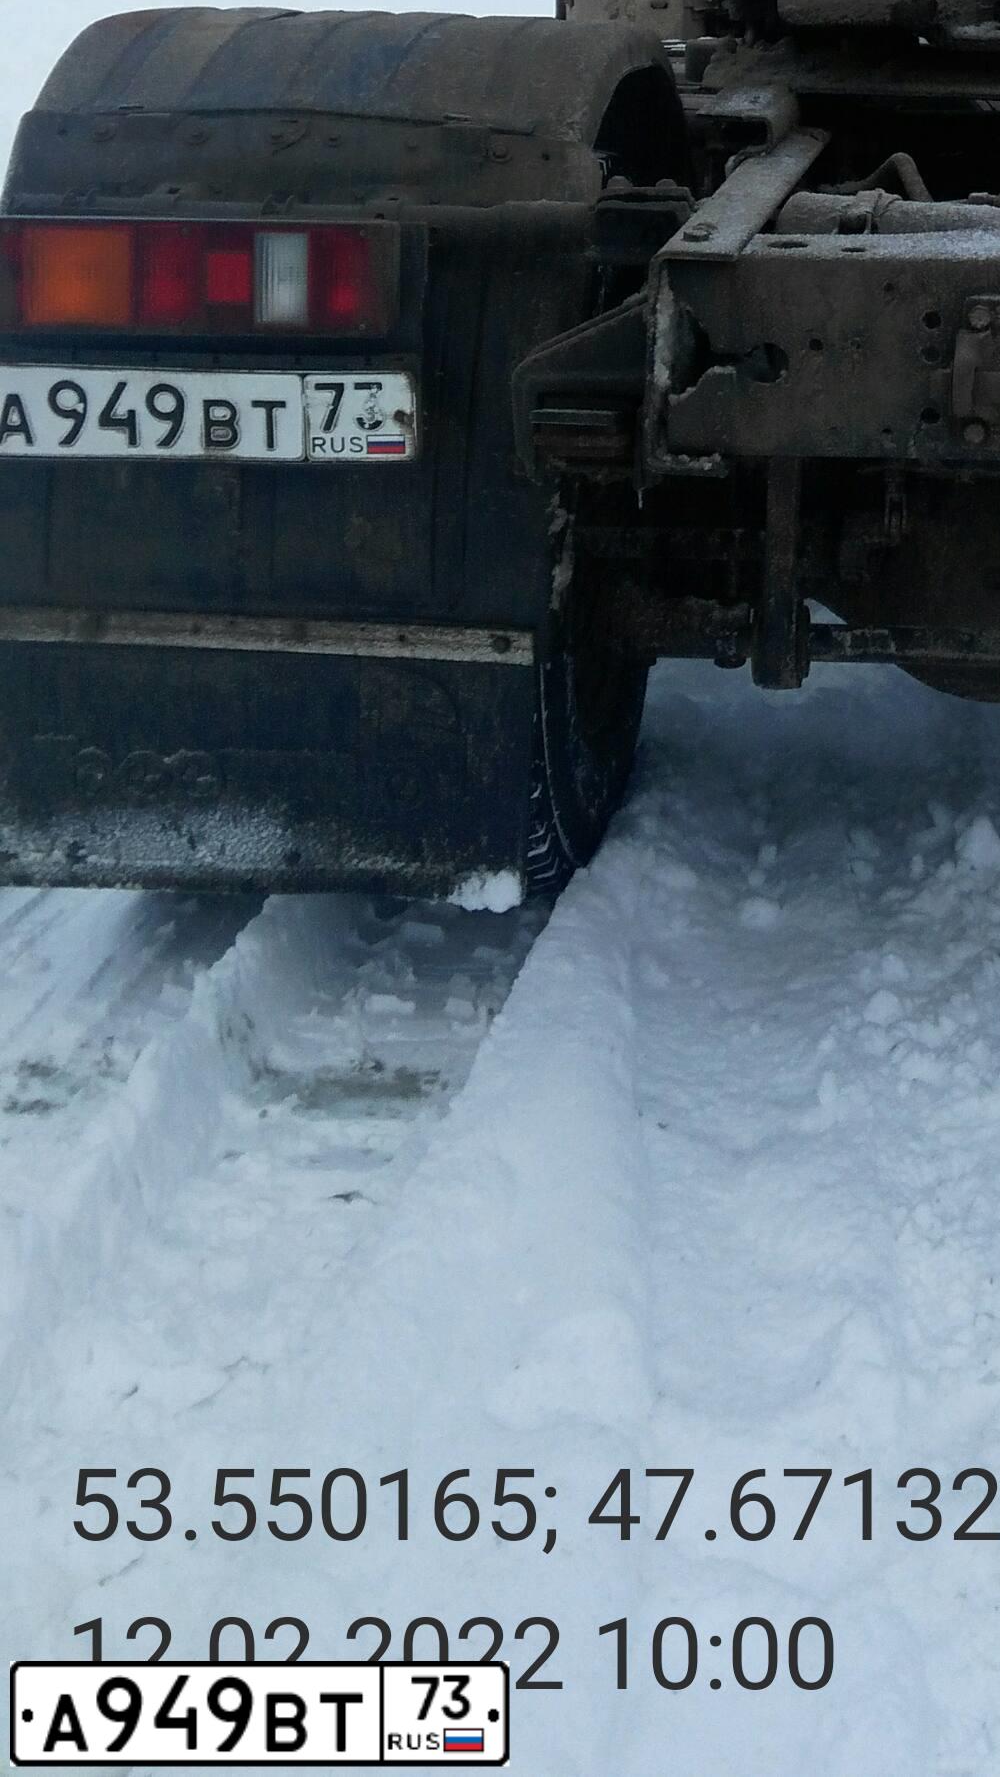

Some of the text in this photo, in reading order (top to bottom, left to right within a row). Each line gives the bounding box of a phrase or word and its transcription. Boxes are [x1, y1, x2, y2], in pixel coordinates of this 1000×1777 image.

[0, 380, 287, 452] А949ВТ
[314, 381, 384, 432] 73
[312, 436, 364, 454] RUS
